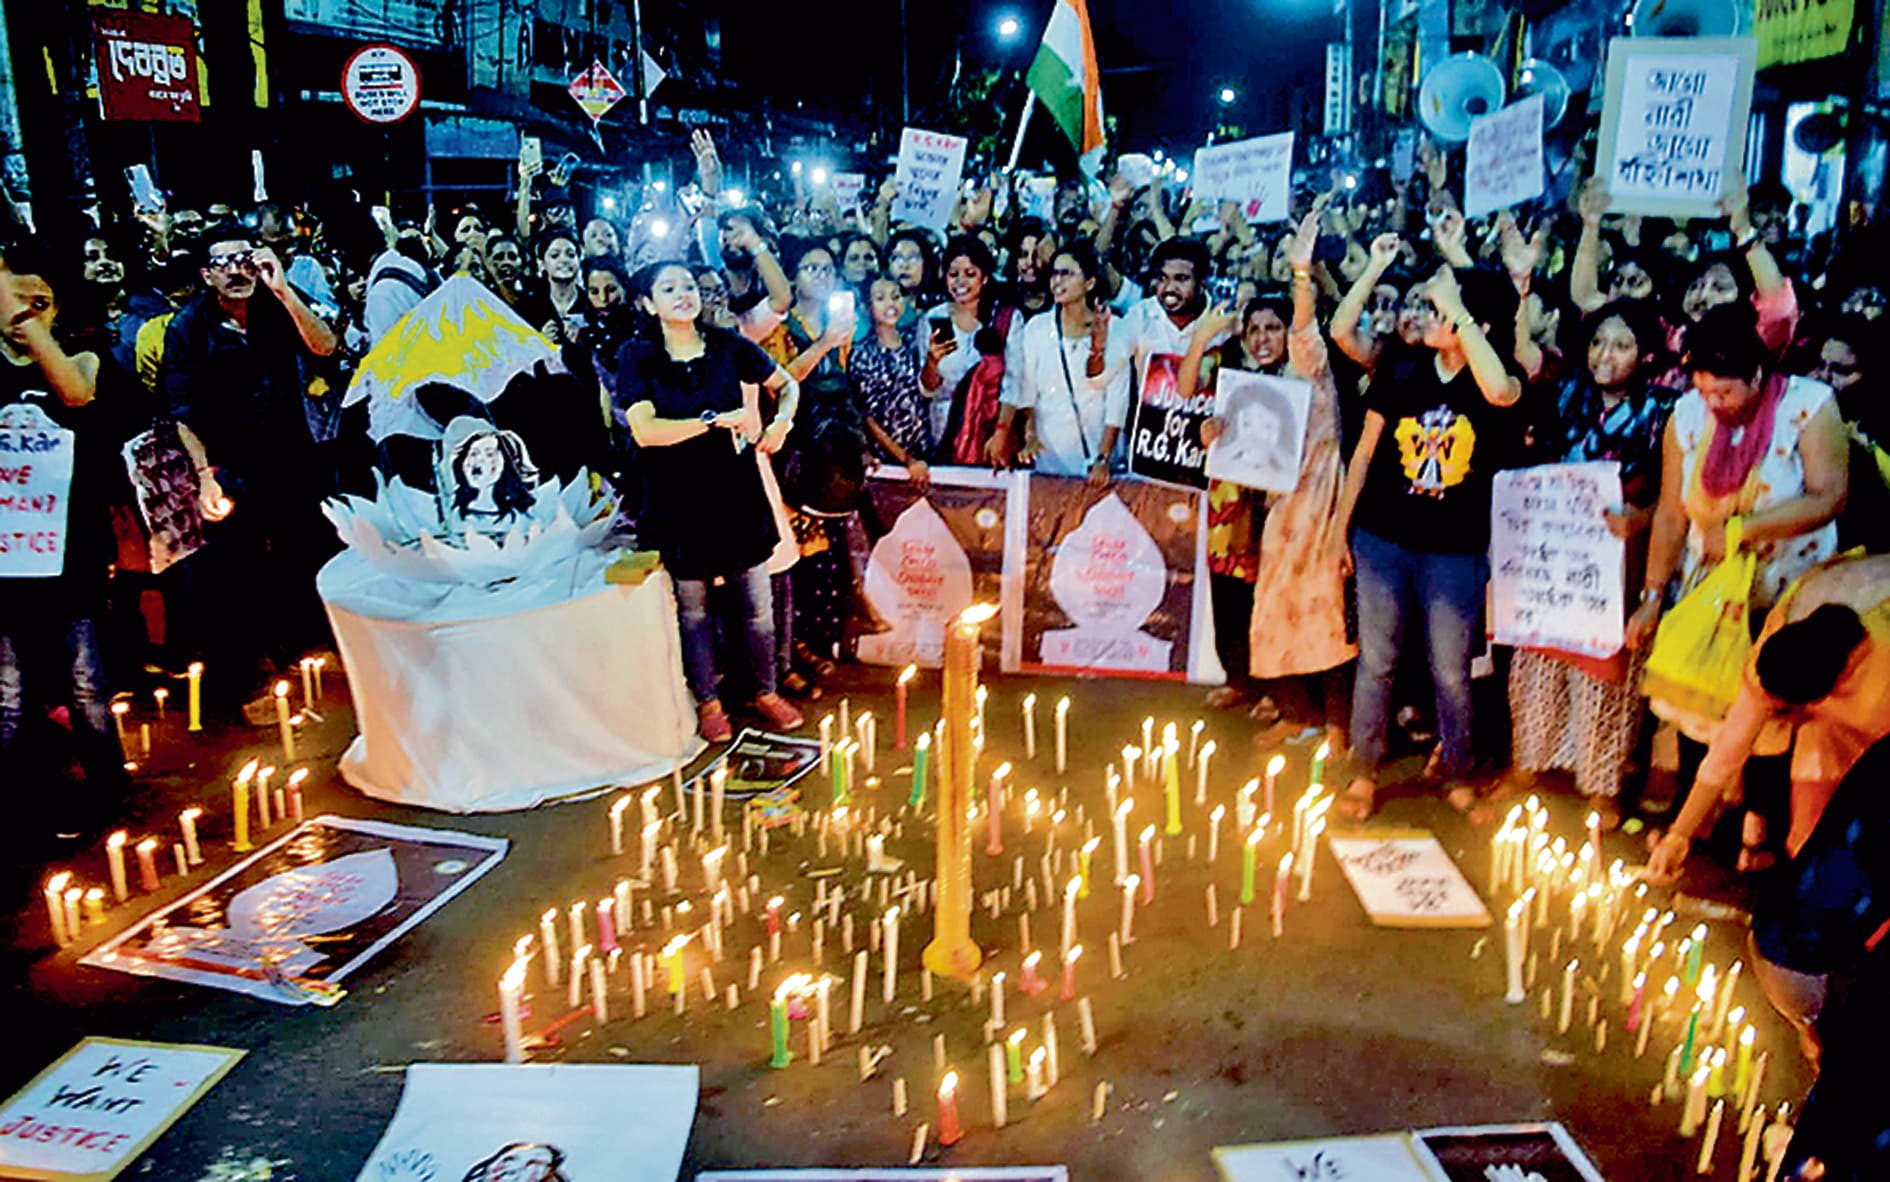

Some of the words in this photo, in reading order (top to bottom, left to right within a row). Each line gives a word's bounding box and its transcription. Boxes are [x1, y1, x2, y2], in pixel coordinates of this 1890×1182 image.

[1164, 402, 1190, 438] for
[1136, 427, 1170, 463] R.G.
[1174, 437, 1207, 469] Kar
[92, 1055, 160, 1083] WE
[44, 1084, 143, 1114] WANT
[0, 1115, 130, 1152] JUSTICE
[1284, 1150, 1341, 1181] WE
